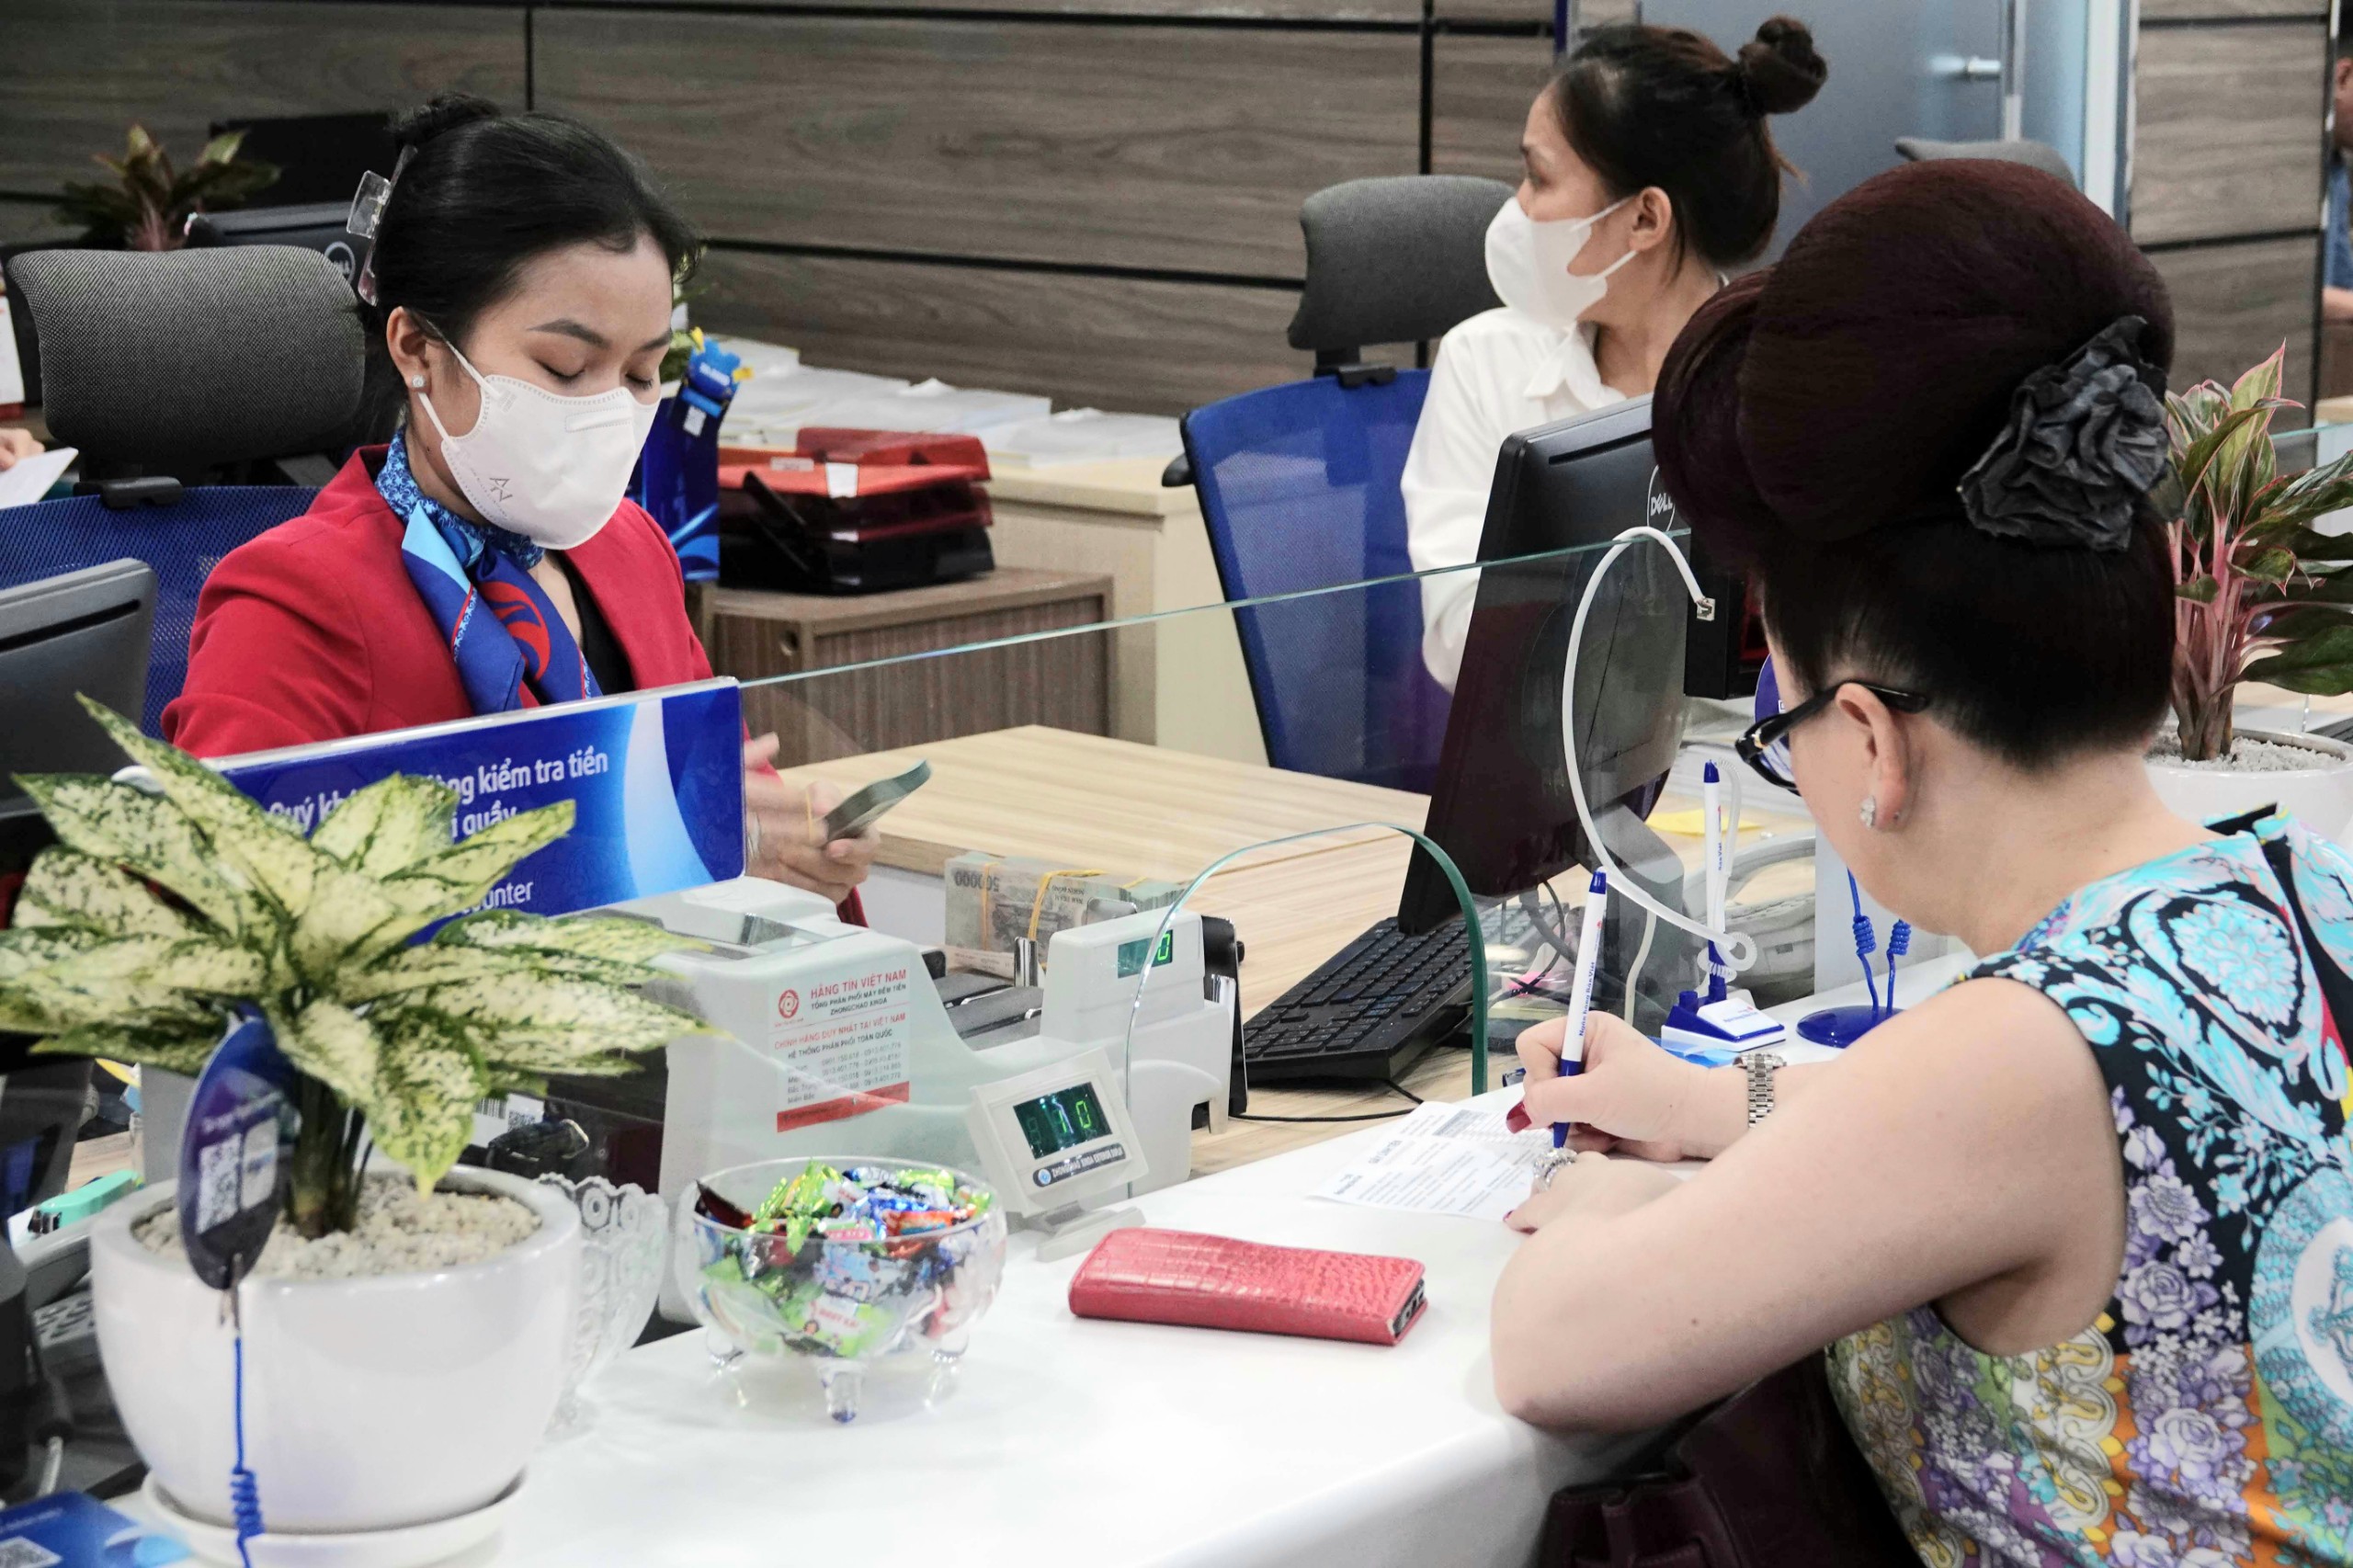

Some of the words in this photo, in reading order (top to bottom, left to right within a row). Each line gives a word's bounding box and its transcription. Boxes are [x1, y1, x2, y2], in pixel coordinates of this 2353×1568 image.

[1651, 493, 1673, 517] DELL
[478, 757, 531, 794] kiểm
[535, 759, 564, 785] tra
[568, 745, 608, 778] tiền
[861, 972, 882, 989] VIỆT
[885, 969, 906, 983] NAM
